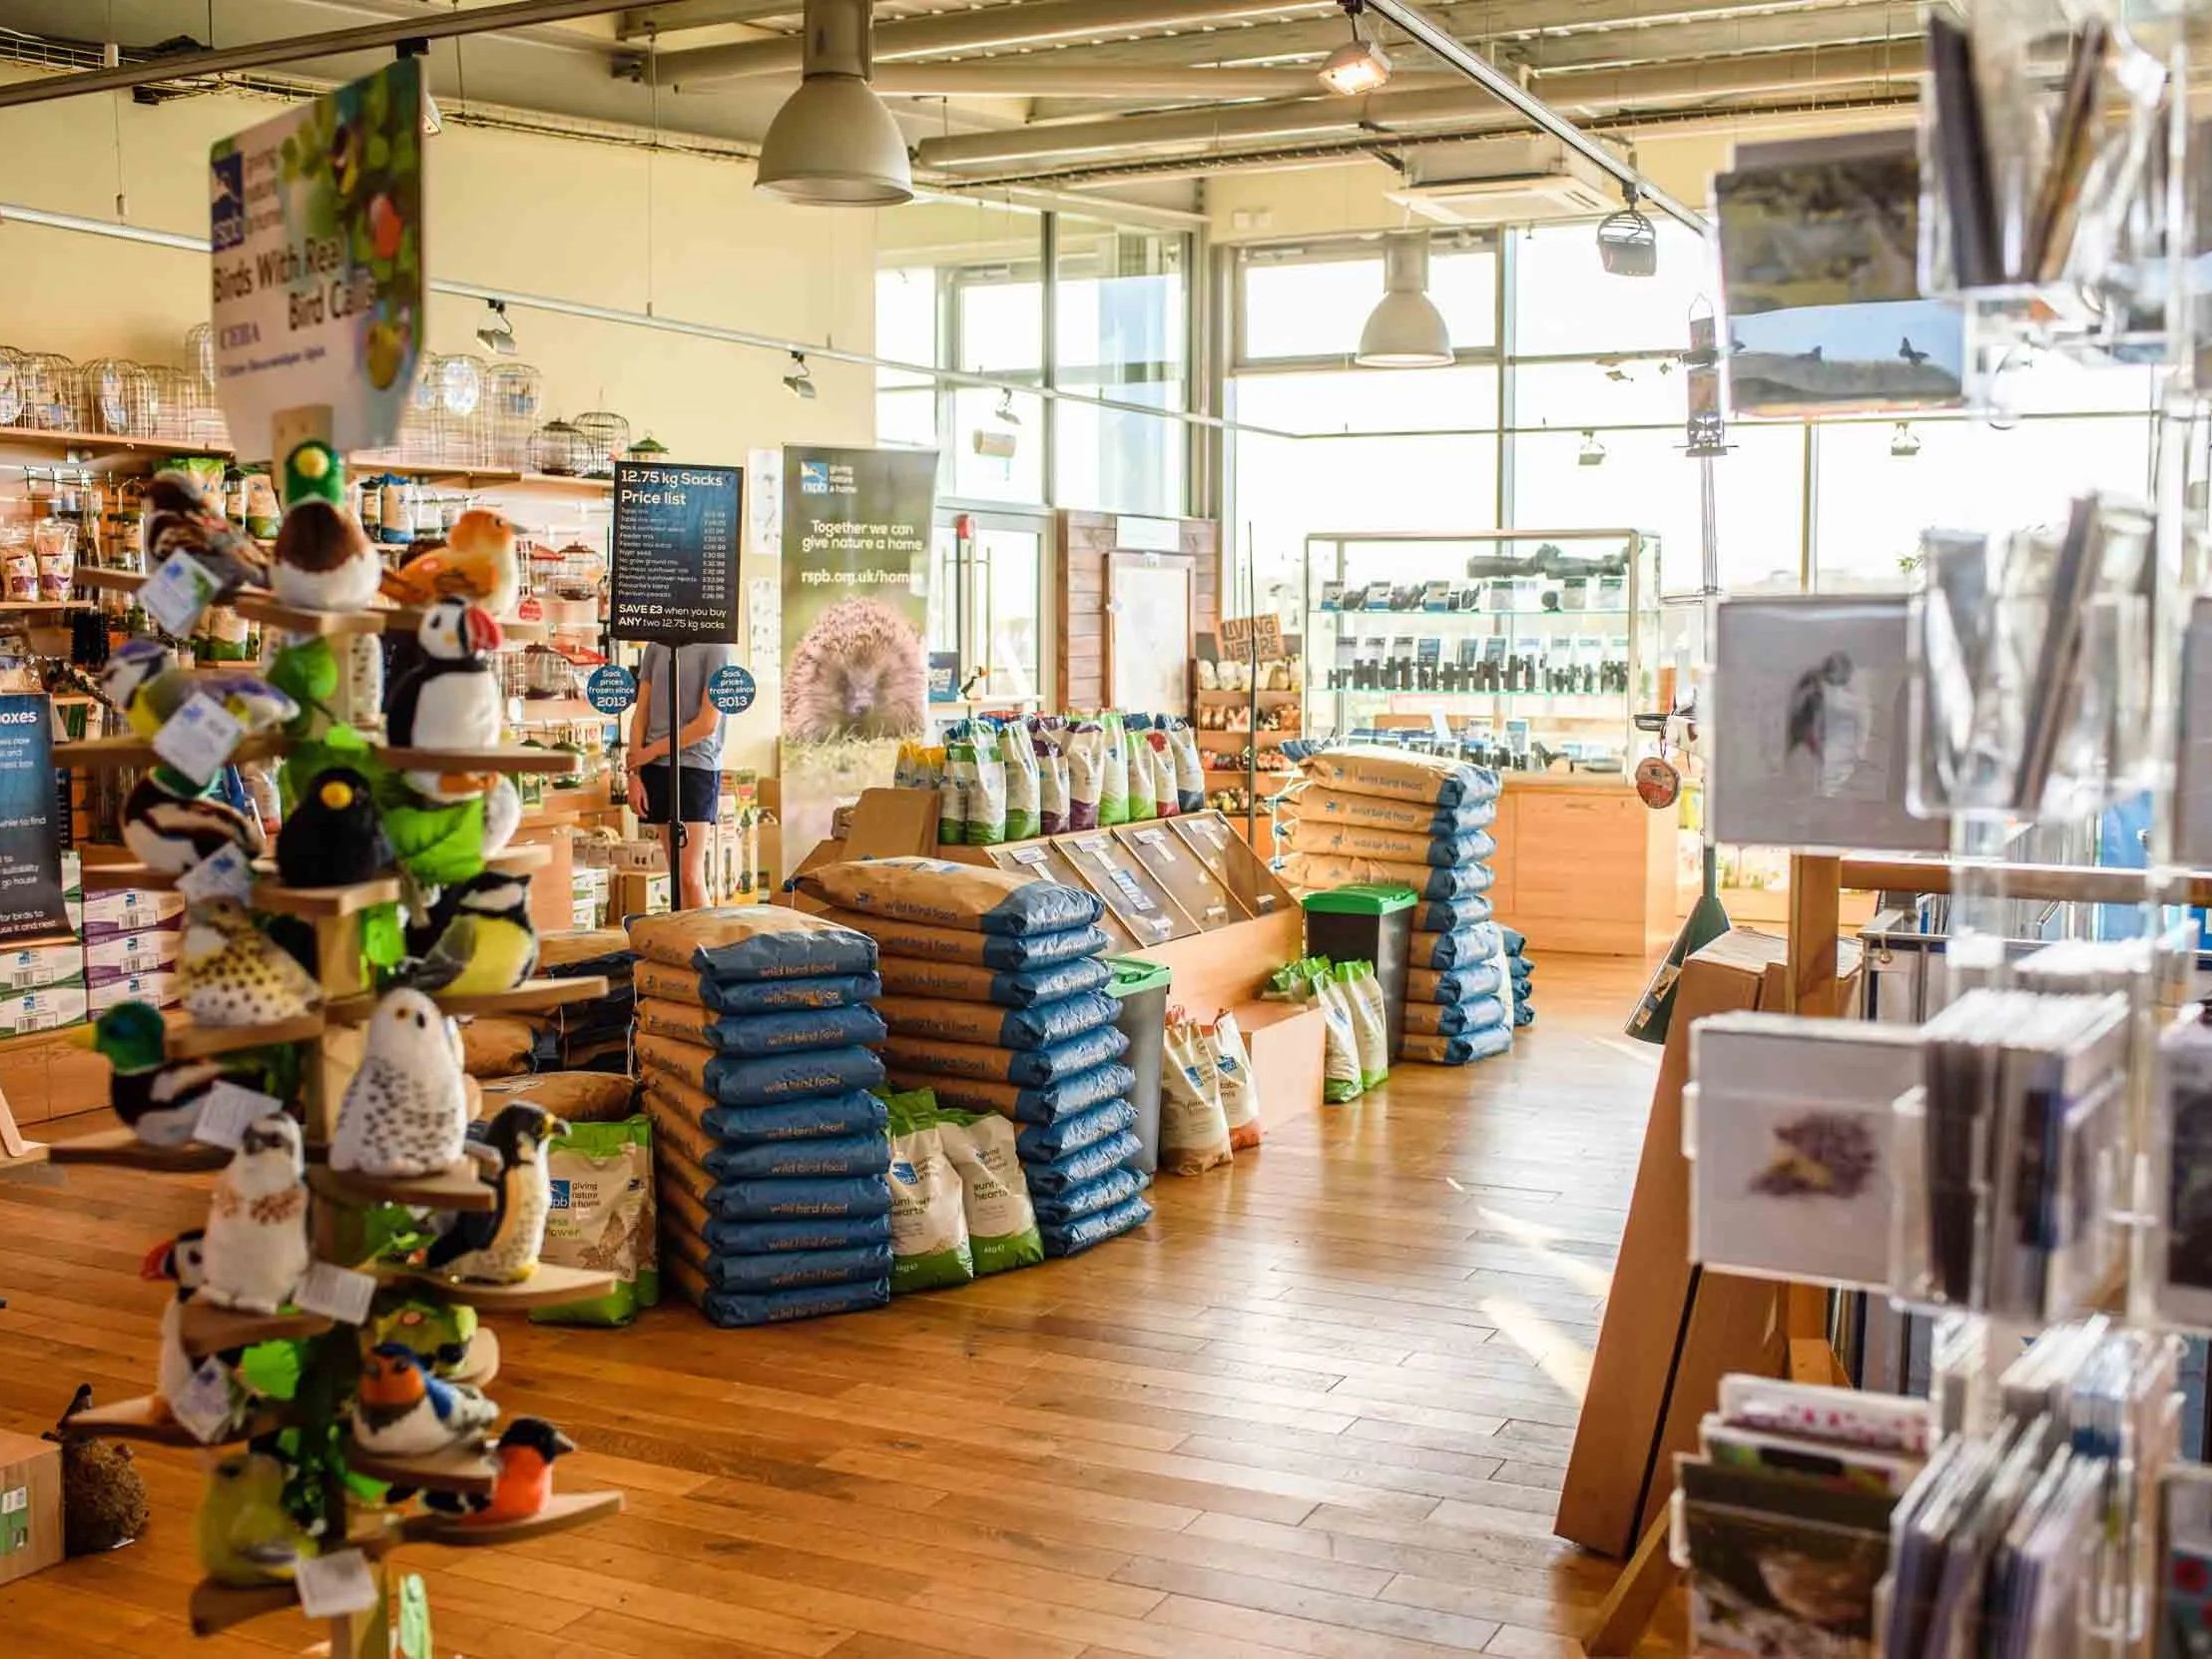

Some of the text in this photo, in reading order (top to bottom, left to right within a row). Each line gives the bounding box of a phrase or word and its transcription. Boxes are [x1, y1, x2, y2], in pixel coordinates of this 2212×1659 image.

[213, 259, 253, 302] Birds
[256, 244, 300, 289] With
[289, 284, 324, 331] Bird
[622, 470, 724, 489] 12.75 kg Sacks
[621, 490, 687, 505] Price list
[811, 519, 913, 539] Together we can
[802, 535, 923, 553] give nature a home
[618, 603, 727, 619] SAVE £3 when you buy
[618, 616, 725, 632] ANY two 12.75 kg sacks
[597, 696, 627, 708] 2013
[718, 696, 748, 708] 2013
[1400, 780, 1422, 792] food
[1392, 811, 1416, 824] food
[771, 1159, 847, 1175] wild bird food
[572, 1181, 599, 1193] giving
